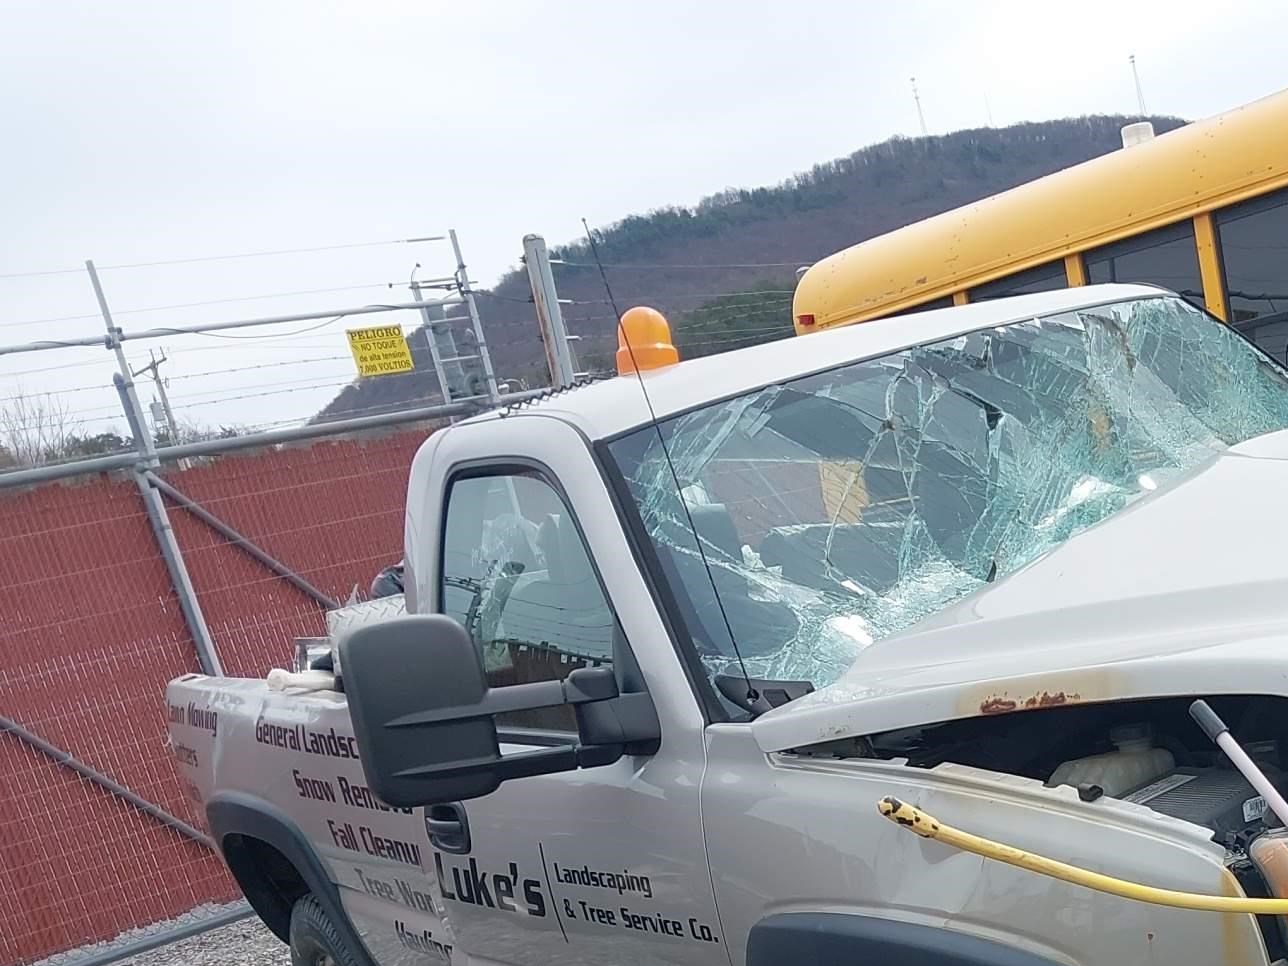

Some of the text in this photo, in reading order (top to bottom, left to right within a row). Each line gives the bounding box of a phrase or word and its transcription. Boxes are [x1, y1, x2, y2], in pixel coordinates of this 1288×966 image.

[350, 327, 401, 340] PELIGRO
[361, 339, 397, 352] NO TOQUE
[378, 359, 412, 371] VOLTIOS
[255, 715, 360, 759] General Landsc
[293, 768, 336, 803] Snow
[327, 819, 360, 853] Fall
[354, 867, 436, 914] Tree Wor
[434, 852, 546, 918] Luke's
[553, 862, 653, 898] Landscaping
[563, 898, 719, 943] & Tree Service Co.
